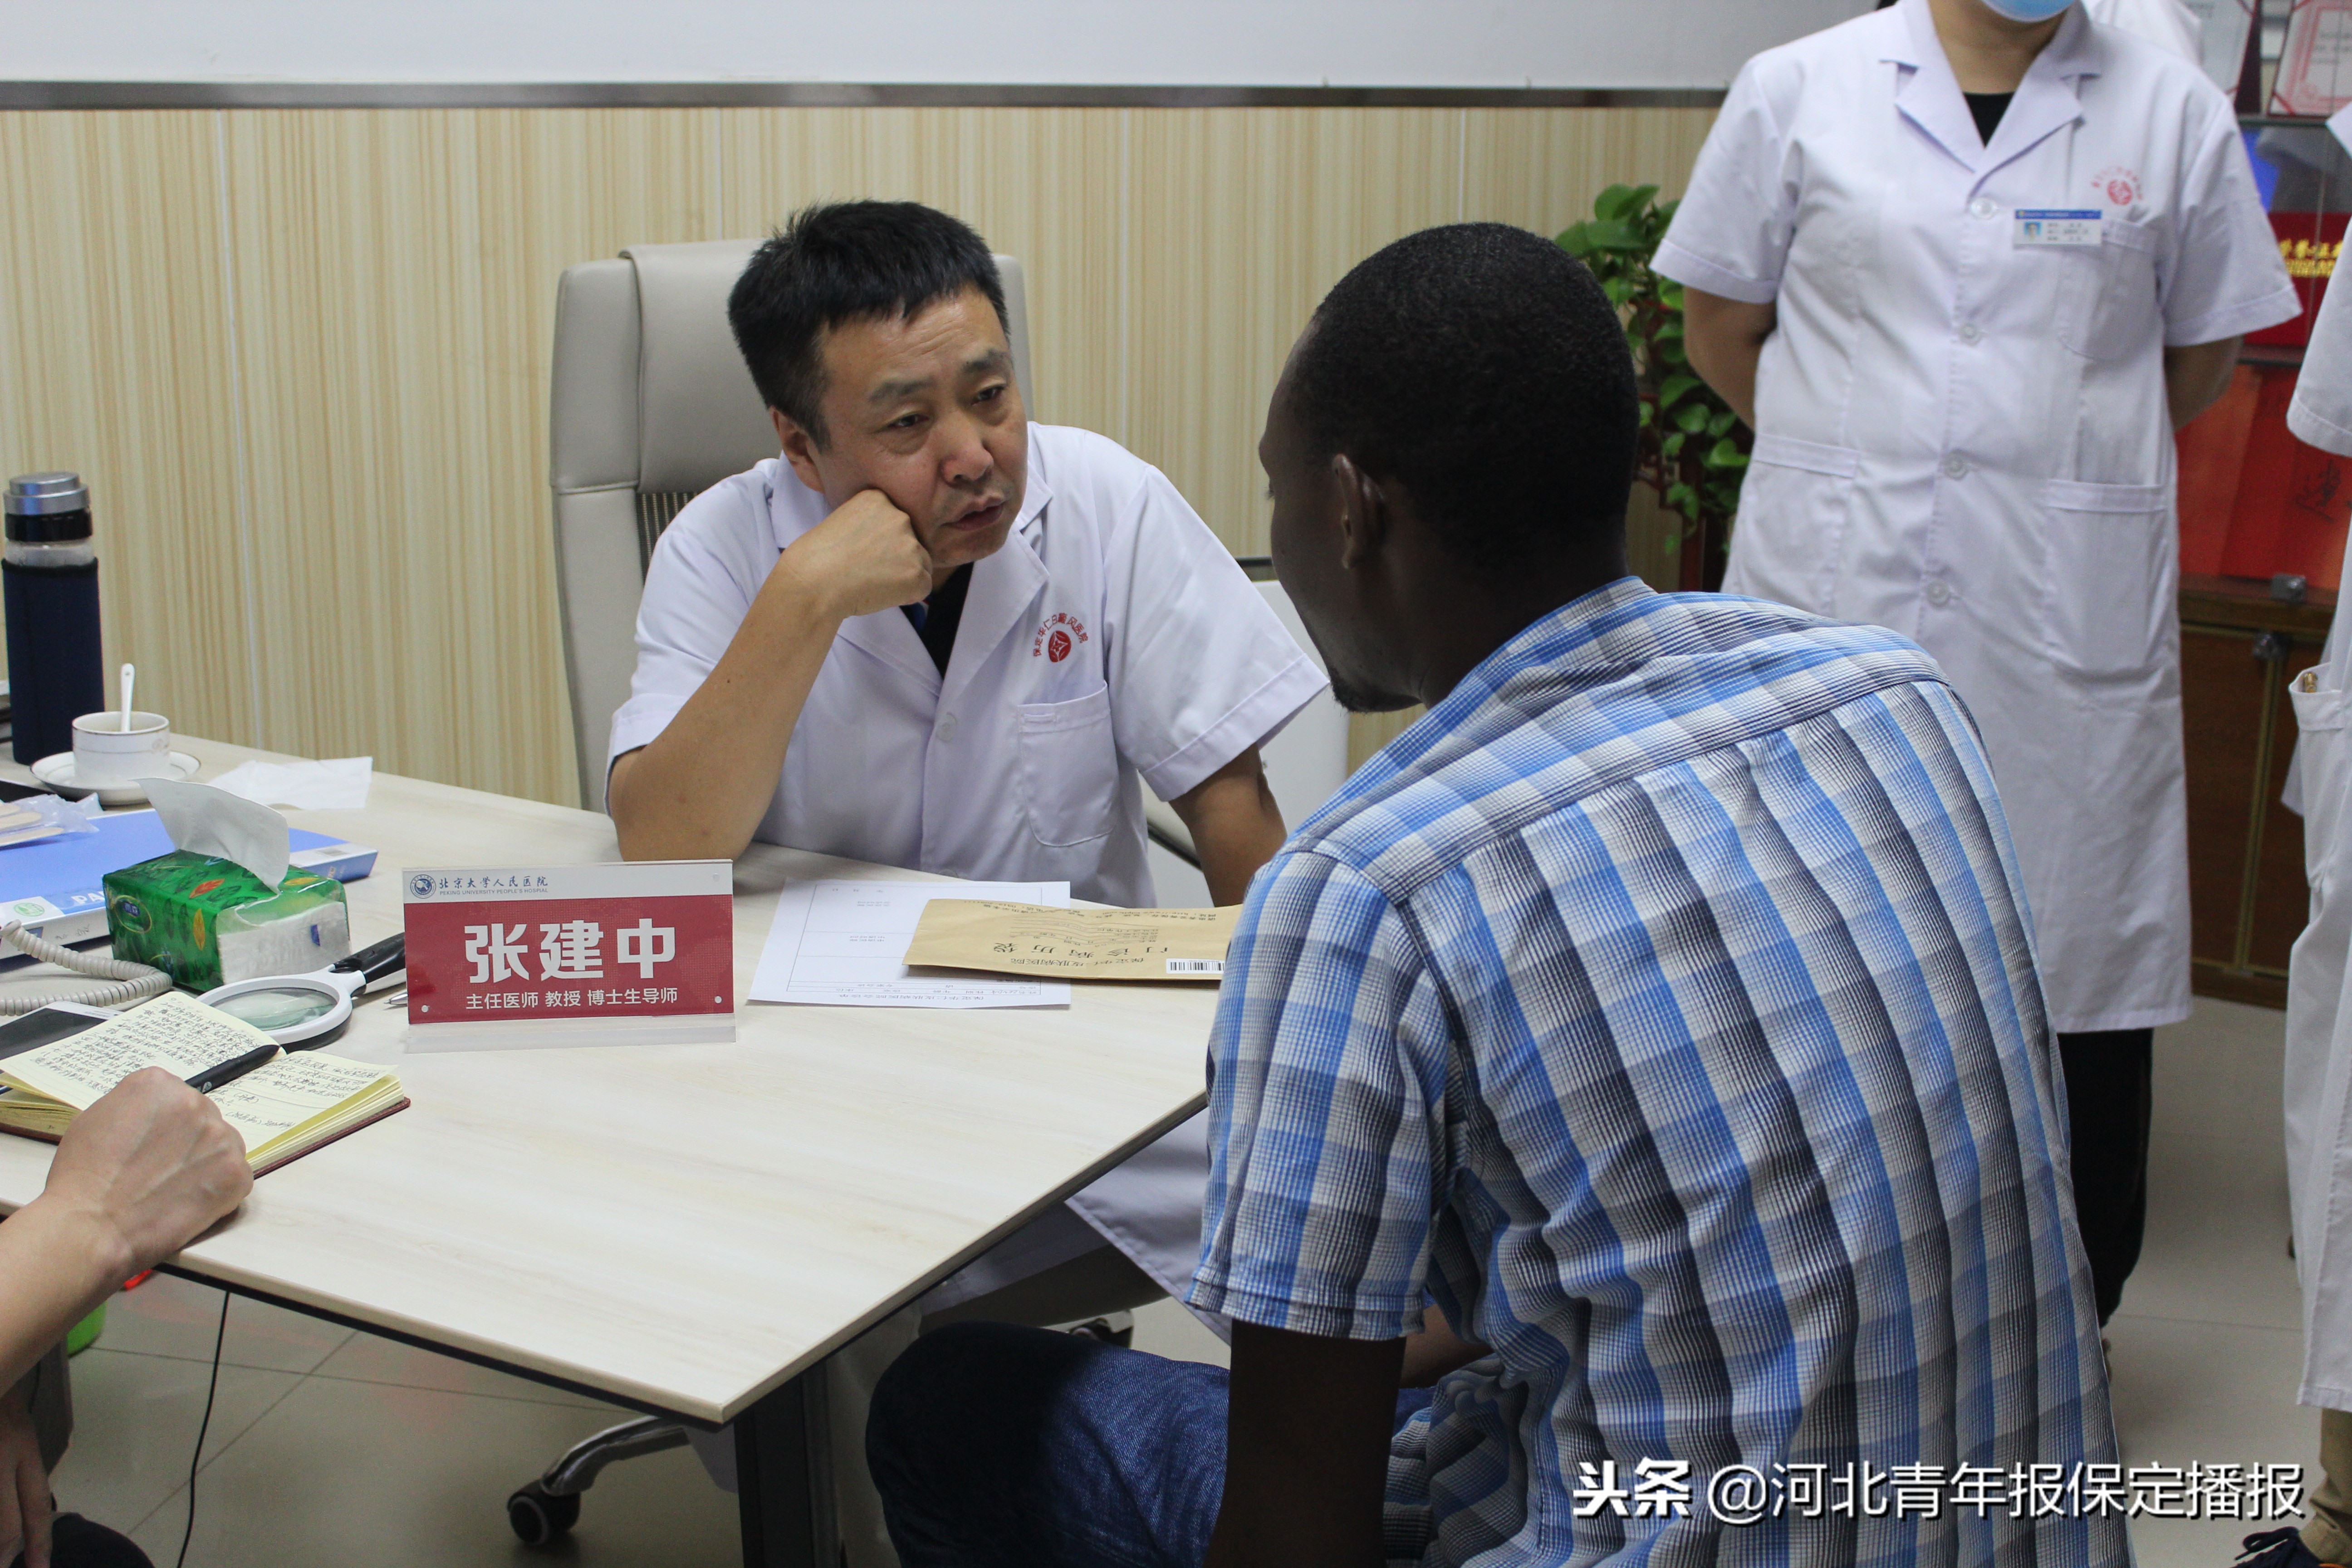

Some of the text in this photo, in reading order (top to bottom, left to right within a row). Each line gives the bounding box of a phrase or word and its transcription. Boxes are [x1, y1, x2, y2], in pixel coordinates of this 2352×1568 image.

[439, 875, 548, 889] 北京大学人民医院
[464, 918, 676, 984] 张建中
[993, 942, 1168, 959] 门诊病历袋
[1010, 957, 1145, 967] 保定华仁皮肤病医院
[466, 987, 678, 1009] 主任医师 教授 博士生导师
